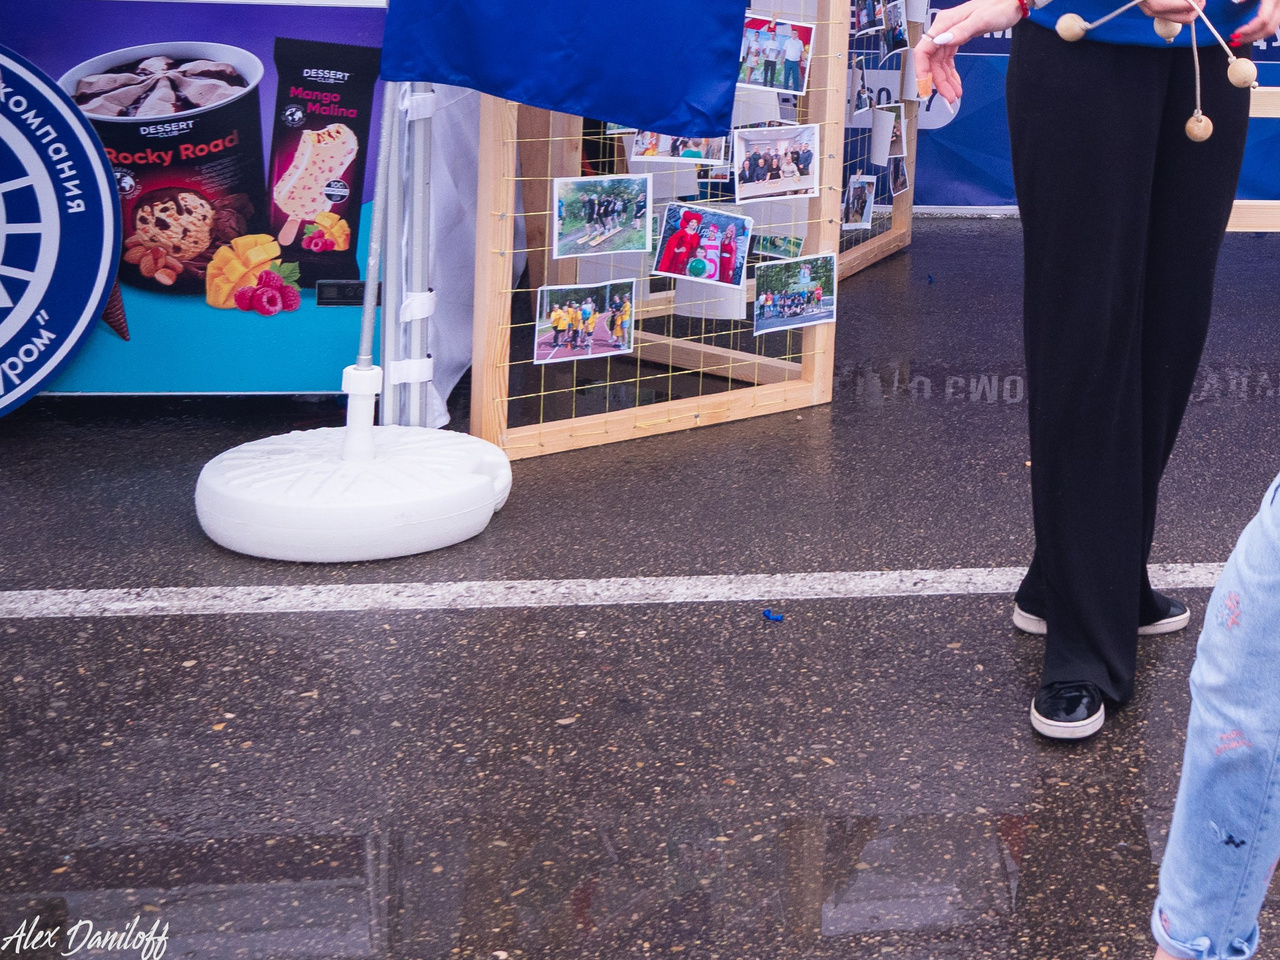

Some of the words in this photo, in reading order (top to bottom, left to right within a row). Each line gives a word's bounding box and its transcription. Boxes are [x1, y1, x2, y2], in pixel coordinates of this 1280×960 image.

[302, 68, 350, 81] DESSERT
[290, 86, 341, 103] Mango
[306, 101, 358, 118] Malina
[139, 120, 195, 135] DESSERT
[104, 147, 174, 167] Rocky
[179, 129, 239, 160] Road
